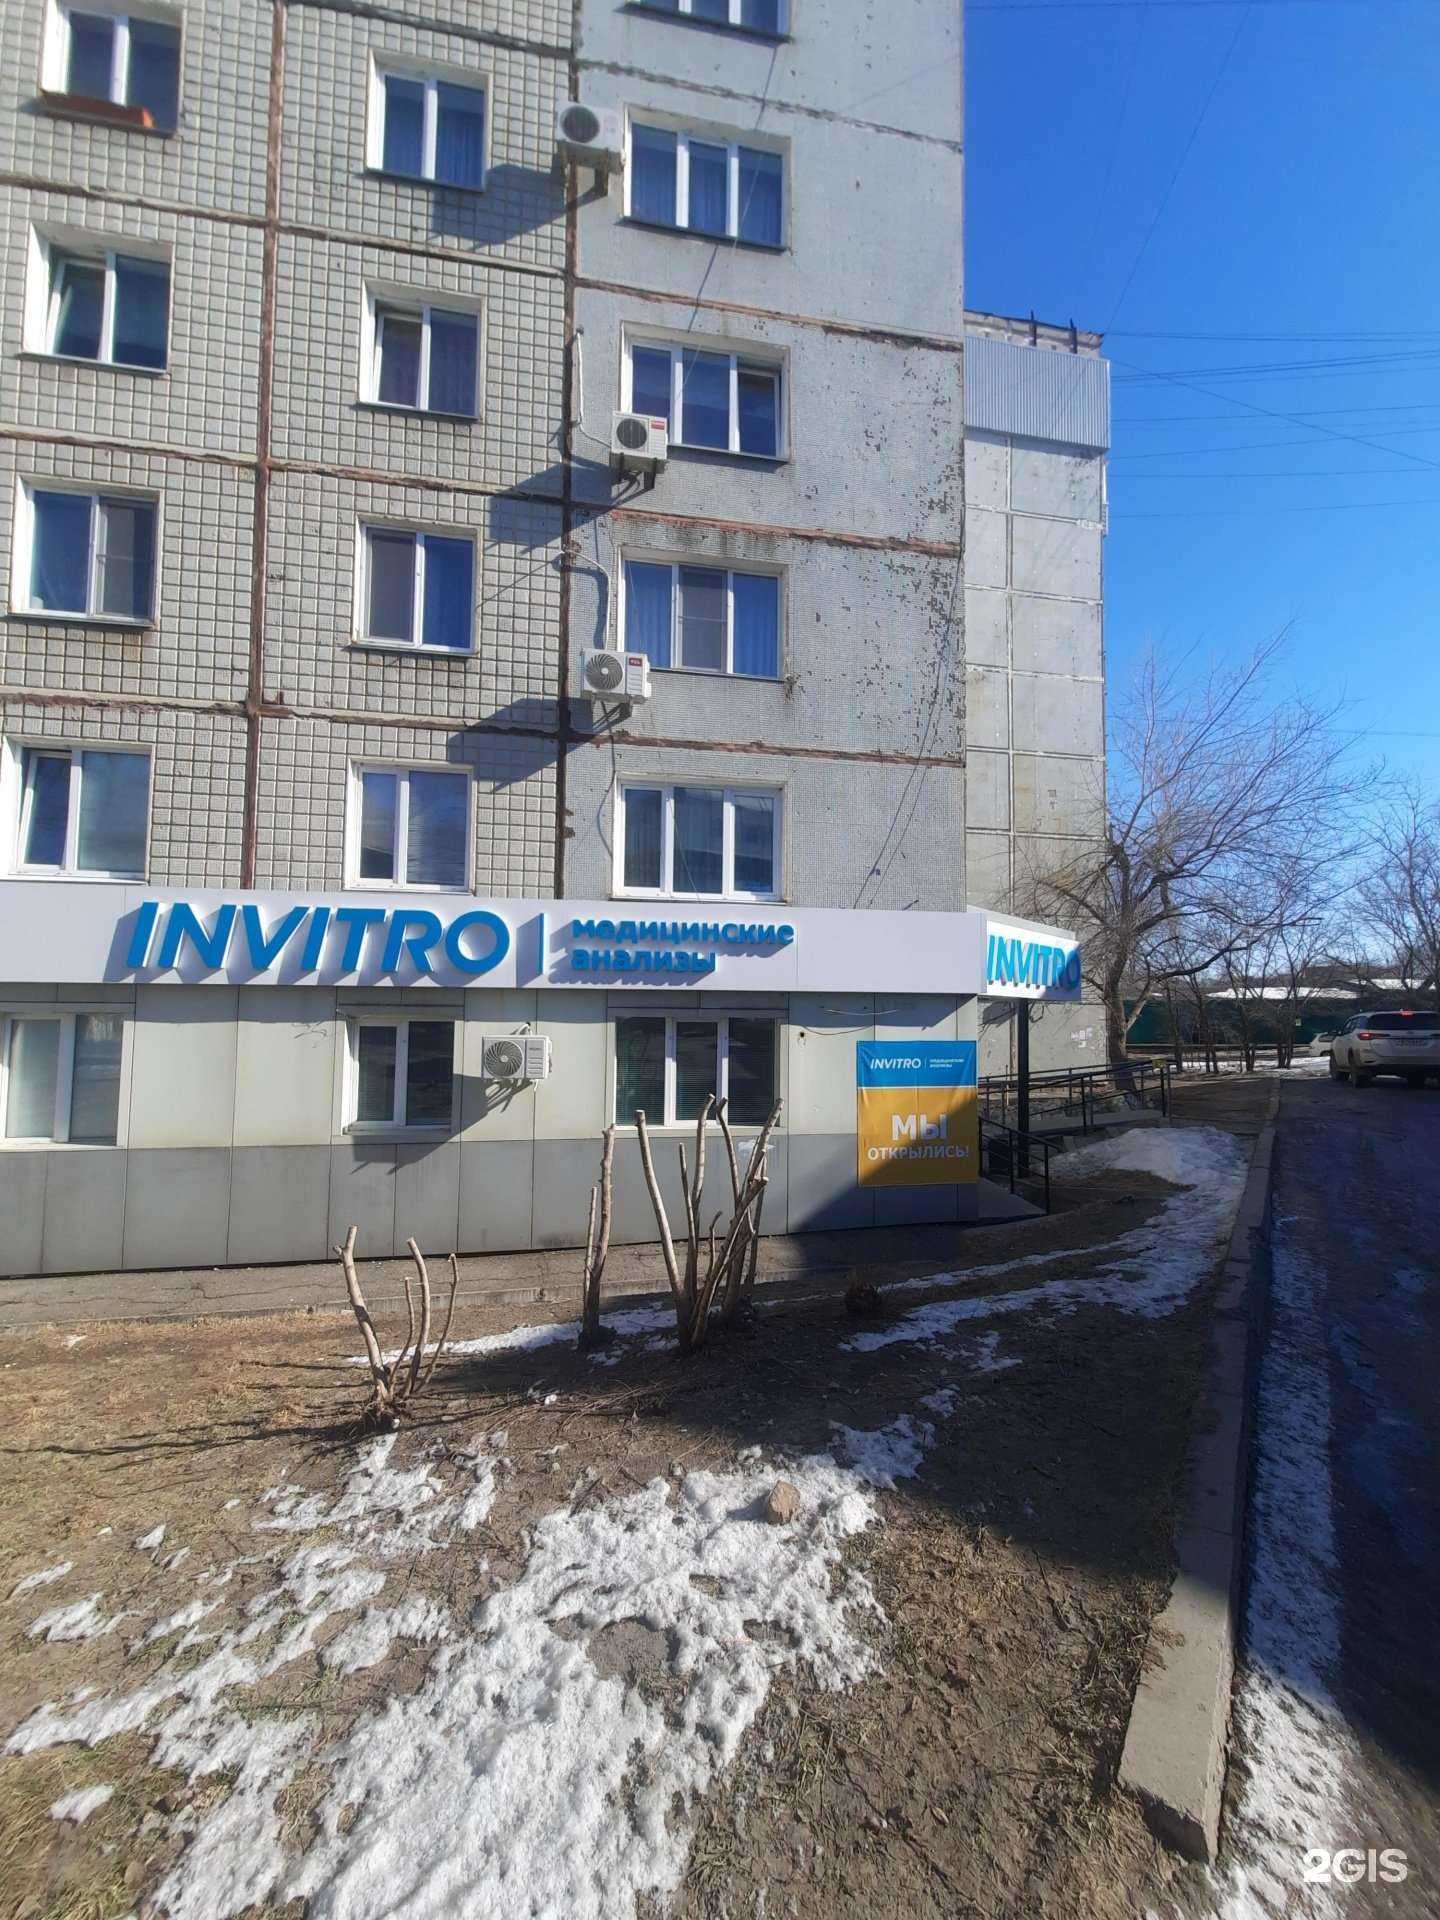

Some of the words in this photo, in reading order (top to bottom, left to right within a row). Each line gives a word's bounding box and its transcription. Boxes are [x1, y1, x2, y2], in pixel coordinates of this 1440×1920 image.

[126, 901, 510, 973] INVITRO
[571, 919, 794, 944] медицинские
[571, 949, 716, 973] анализы
[987, 934, 1081, 990] INVITRO
[870, 1058, 921, 1069] INVITRO
[892, 1114, 947, 1140] МЫ
